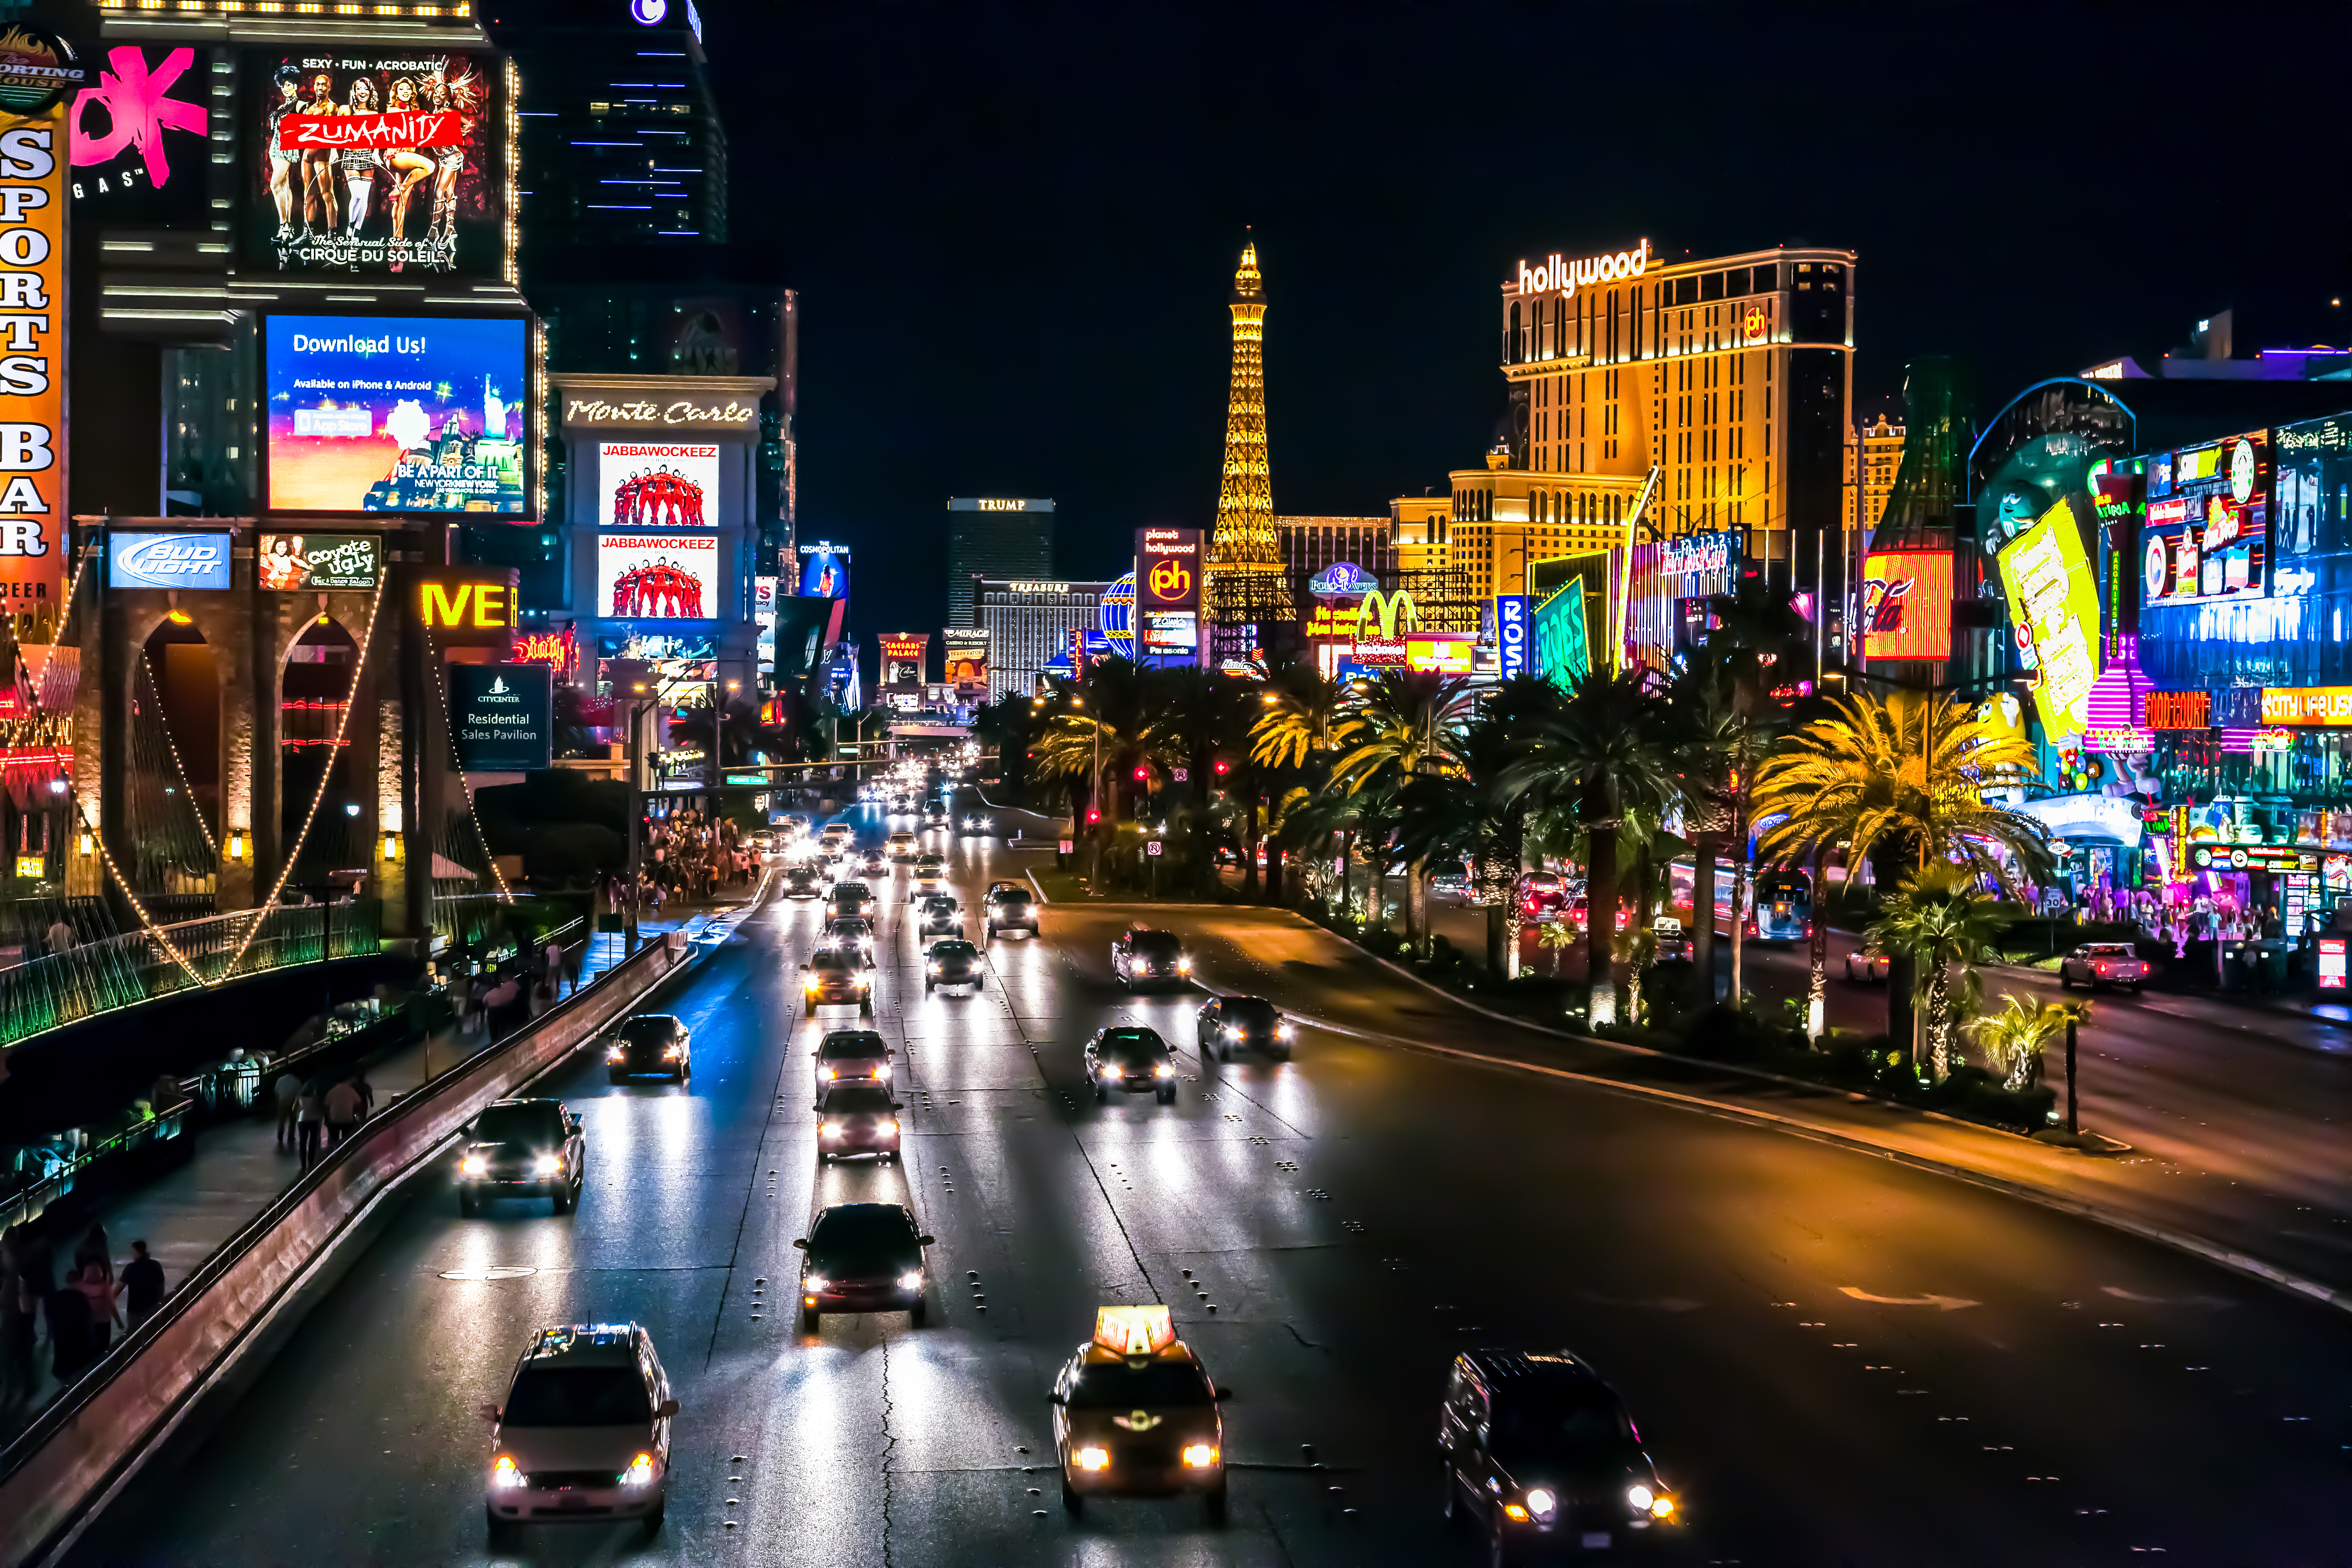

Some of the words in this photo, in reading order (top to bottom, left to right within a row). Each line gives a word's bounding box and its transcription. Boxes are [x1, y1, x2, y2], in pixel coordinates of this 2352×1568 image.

[302, 59, 333, 69] SEXY
[342, 60, 366, 70] FUN
[376, 60, 443, 71] ACROBATIC
[312, 234, 334, 246] The
[335, 236, 386, 246] Sensual
[387, 237, 412, 247] Side
[415, 238, 428, 250] of
[0, 128, 55, 397] SPORTS
[300, 248, 357, 265] CIRQUE
[362, 250, 383, 262] DU
[1519, 238, 1648, 299] hollywood
[294, 335, 389, 353] Download
[397, 336, 426, 354] Us!
[294, 379, 335, 389] Available
[352, 380, 383, 390] iPhone
[385, 381, 392, 389] &
[395, 380, 432, 390] Android
[567, 400, 658, 422] Monte
[663, 402, 753, 424] Carlo
[313, 420, 337, 433] App
[338, 420, 368, 432] Store
[603, 446, 716, 457] JABBAWOCKEEZ
[398, 464, 414, 477] BE
[417, 464, 428, 477] A
[430, 465, 462, 478] PART
[464, 466, 484, 479] OF
[487, 466, 499, 479] IT.
[0, 422, 54, 557] BAR
[979, 500, 1025, 511] TRUMP
[1146, 529, 1179, 541] planet
[602, 538, 715, 549] JABBAWOCKEEZ
[1146, 543, 1195, 555] hollywood
[147, 544, 217, 560] BUD
[308, 540, 371, 564] coyote
[132, 558, 223, 574] LIGHT
[328, 551, 374, 575] ugly
[1154, 560, 1190, 595] ph
[0, 583, 46, 597] BEER
[1010, 583, 1069, 592] TREASURE
[1311, 580, 1338, 590] POLO
[2145, 691, 2169, 728] FOOD
[2173, 691, 2206, 728] COURT
[469, 714, 529, 724] Residential
[462, 729, 490, 739] Sales
[494, 729, 536, 740] Pavilion
[2267, 860, 2299, 869] SUBWAY
